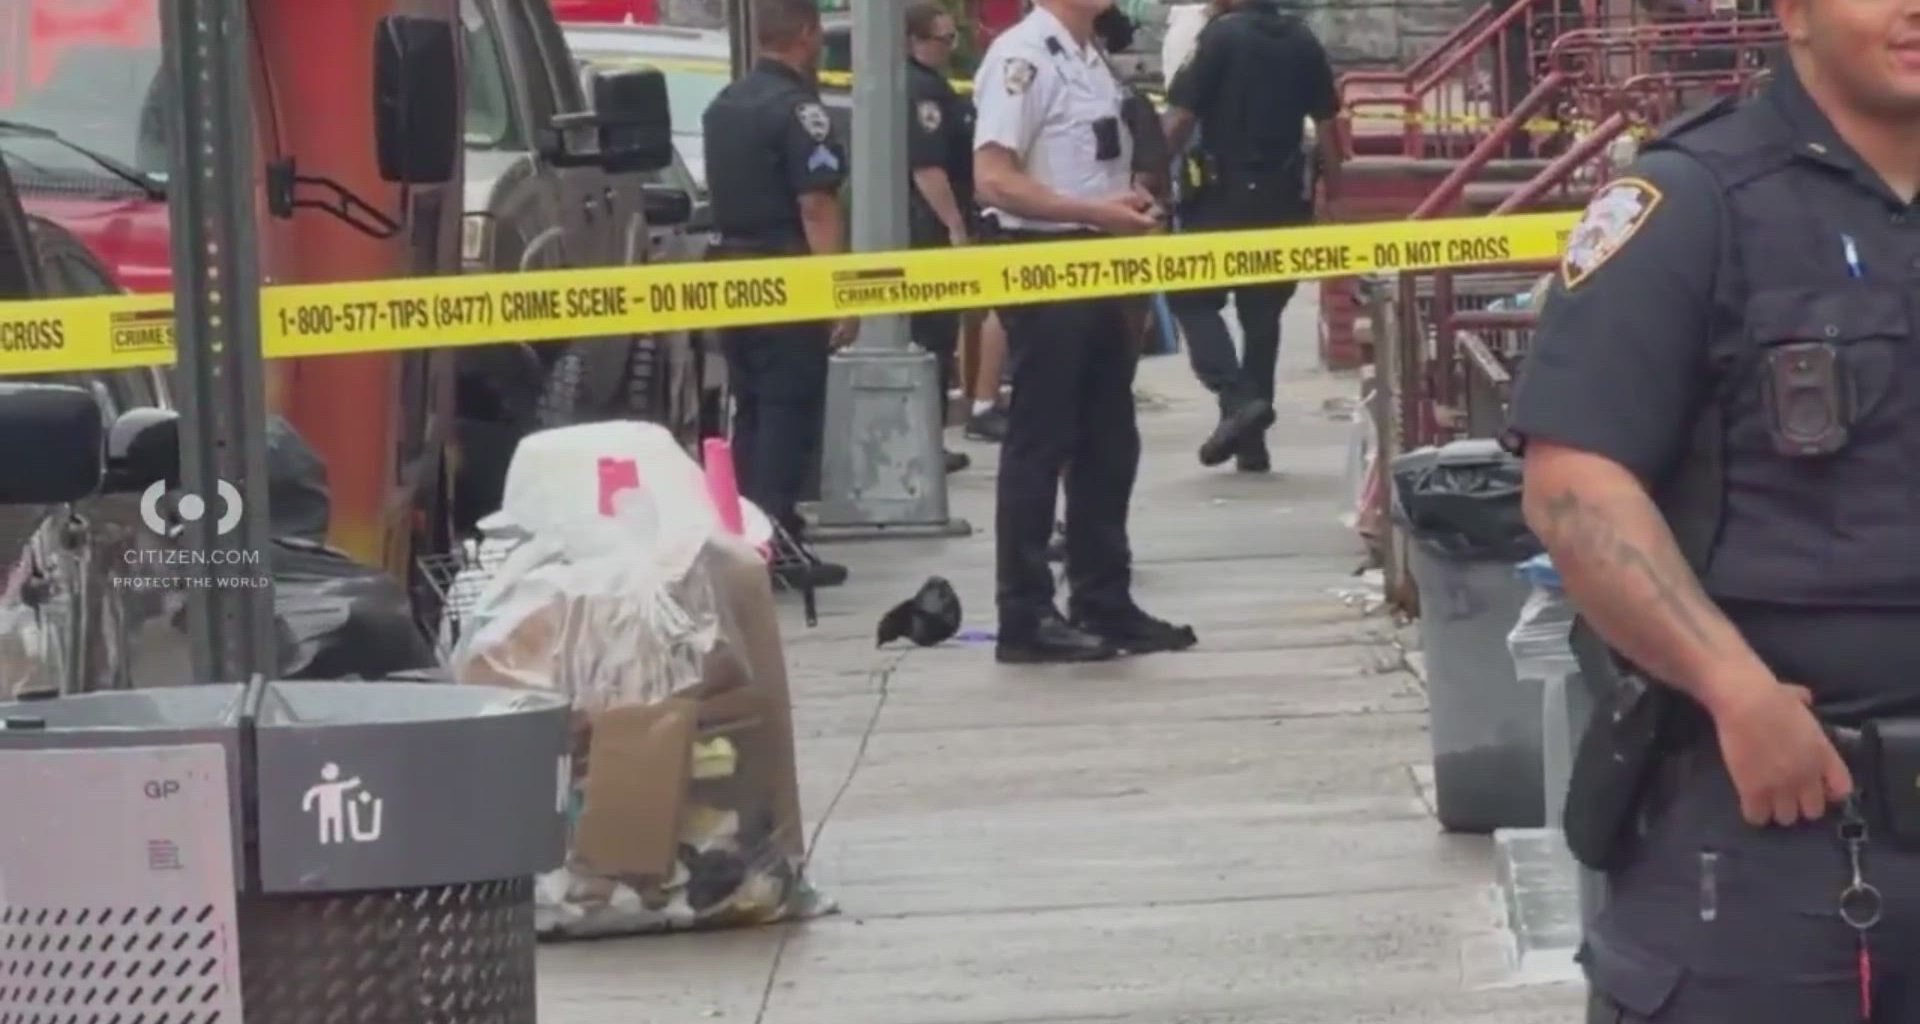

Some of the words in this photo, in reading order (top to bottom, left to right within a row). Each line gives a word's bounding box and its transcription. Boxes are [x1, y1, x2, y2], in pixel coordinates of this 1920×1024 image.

[1002, 257, 1153, 292] 1-800-577-TIPS
[1157, 251, 1216, 283] (8477)
[1224, 250, 1285, 277] CRIME
[1290, 246, 1351, 273] SCENE
[1374, 243, 1399, 268] DO
[1405, 240, 1442, 265] NOT
[1447, 236, 1510, 261] CROSS
[2, 319, 64, 351] CROSS
[278, 299, 429, 337] 1-800-577-TIPS
[433, 292, 493, 328] (8477)
[501, 290, 561, 322] CRIME
[566, 286, 628, 318] SCENE
[650, 283, 676, 312] DO
[682, 281, 718, 311] NOT
[724, 277, 788, 308] CROSS
